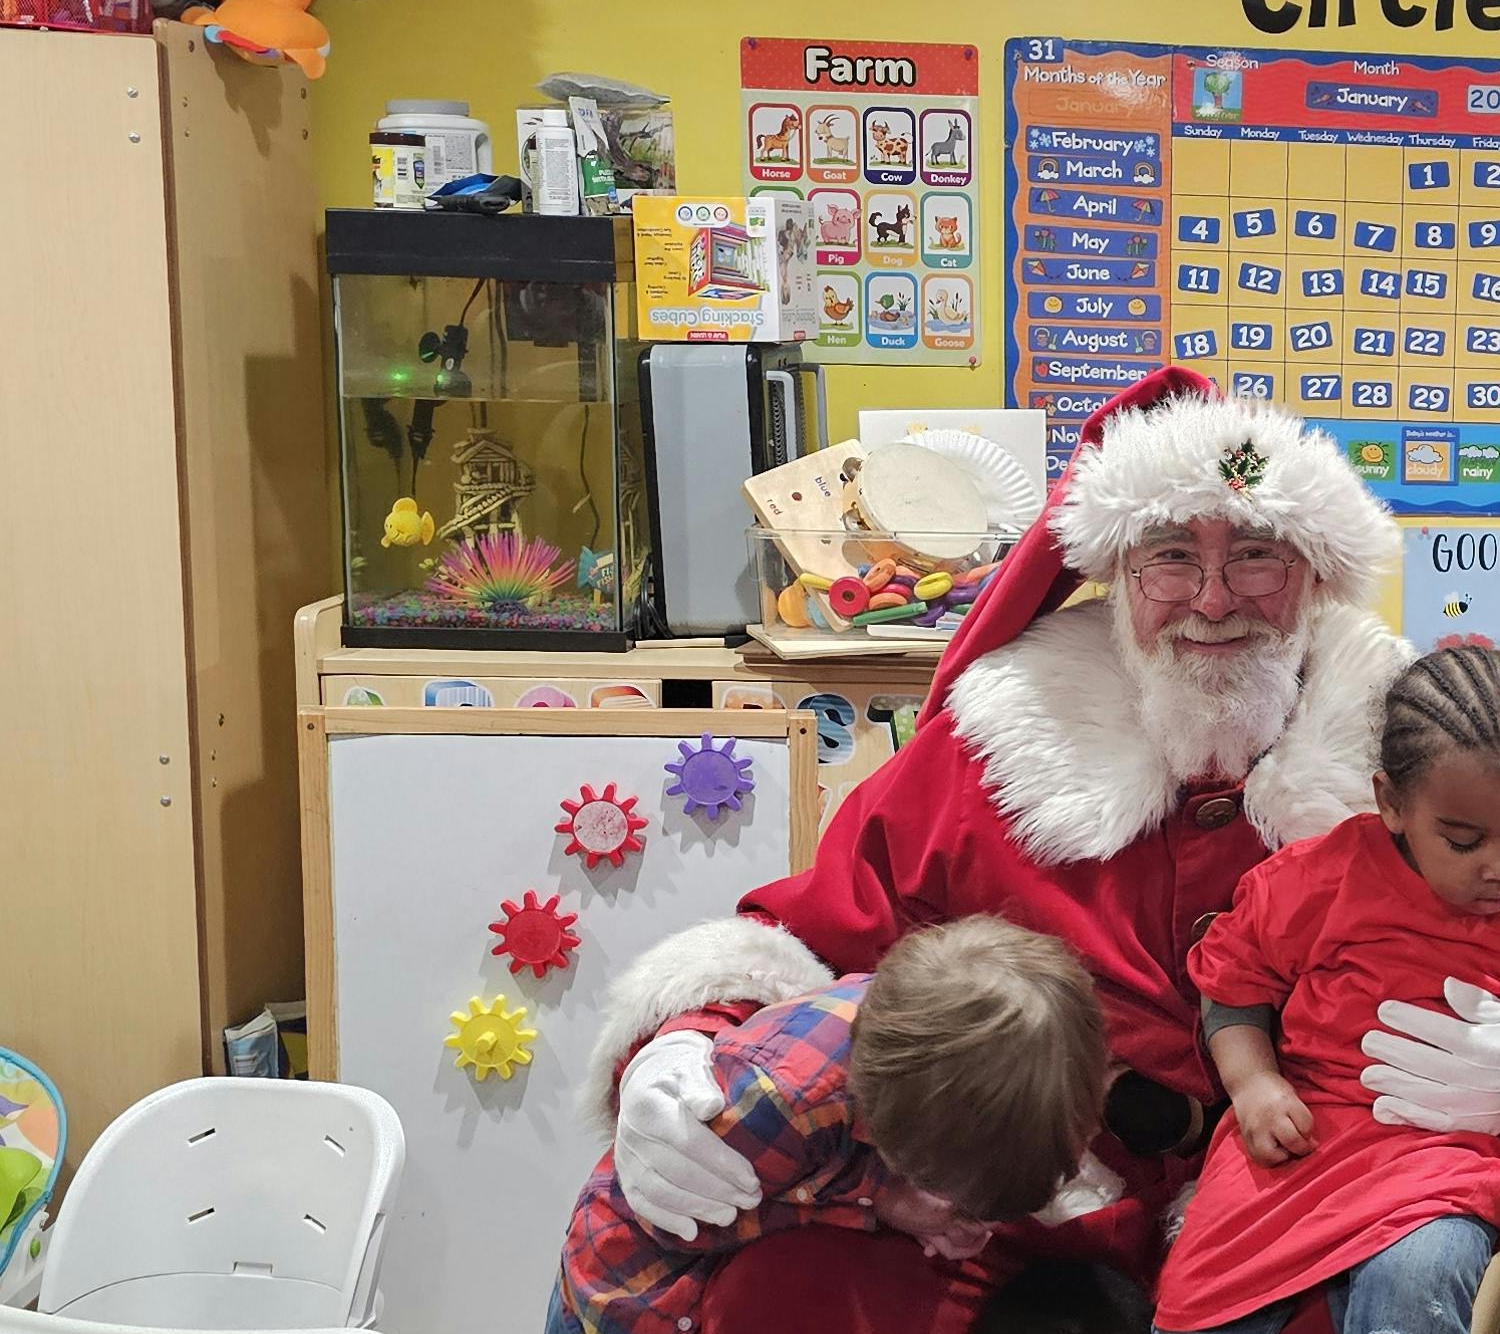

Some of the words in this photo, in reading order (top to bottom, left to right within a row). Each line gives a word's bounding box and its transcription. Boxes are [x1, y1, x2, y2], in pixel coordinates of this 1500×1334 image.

[1027, 38, 1057, 61] 31
[804, 45, 917, 87] Farm
[1205, 54, 1259, 69] Season
[1353, 60, 1400, 76] Month
[1023, 65, 1086, 85] Months
[1088, 71, 1107, 85] of
[1108, 72, 1127, 87] the
[1128, 70, 1167, 88] Year
[1336, 87, 1409, 113] January
[1183, 124, 1223, 139] Sunday
[1240, 127, 1281, 142] Monday
[1298, 130, 1339, 144] Tuesday
[1346, 131, 1404, 146] Wednesday
[1051, 131, 1134, 156] February
[1409, 135, 1457, 149] Thursday
[761, 168, 792, 181] Horse
[823, 169, 847, 182] Goat
[880, 171, 903, 183] Cow
[930, 172, 967, 186] Donkey
[1066, 160, 1123, 180] March
[1072, 195, 1118, 217] April
[1192, 219, 1209, 241] 4
[1071, 232, 1110, 254] May
[827, 253, 845, 267] Pig
[940, 257, 958, 269] Cat
[1066, 263, 1111, 282] June
[1412, 270, 1440, 293] 15
[1075, 297, 1114, 318] July
[648, 308, 695, 327] Cubes
[696, 308, 765, 327] Stacking
[826, 334, 848, 346] Hen
[880, 335, 907, 348] Duck
[934, 337, 966, 349] Goose
[1062, 330, 1129, 351] August
[1295, 325, 1328, 348] 20
[1048, 361, 1147, 383] September
[1462, 463, 1494, 479] rainy
[814, 476, 832, 498] blue
[766, 498, 784, 516] red
